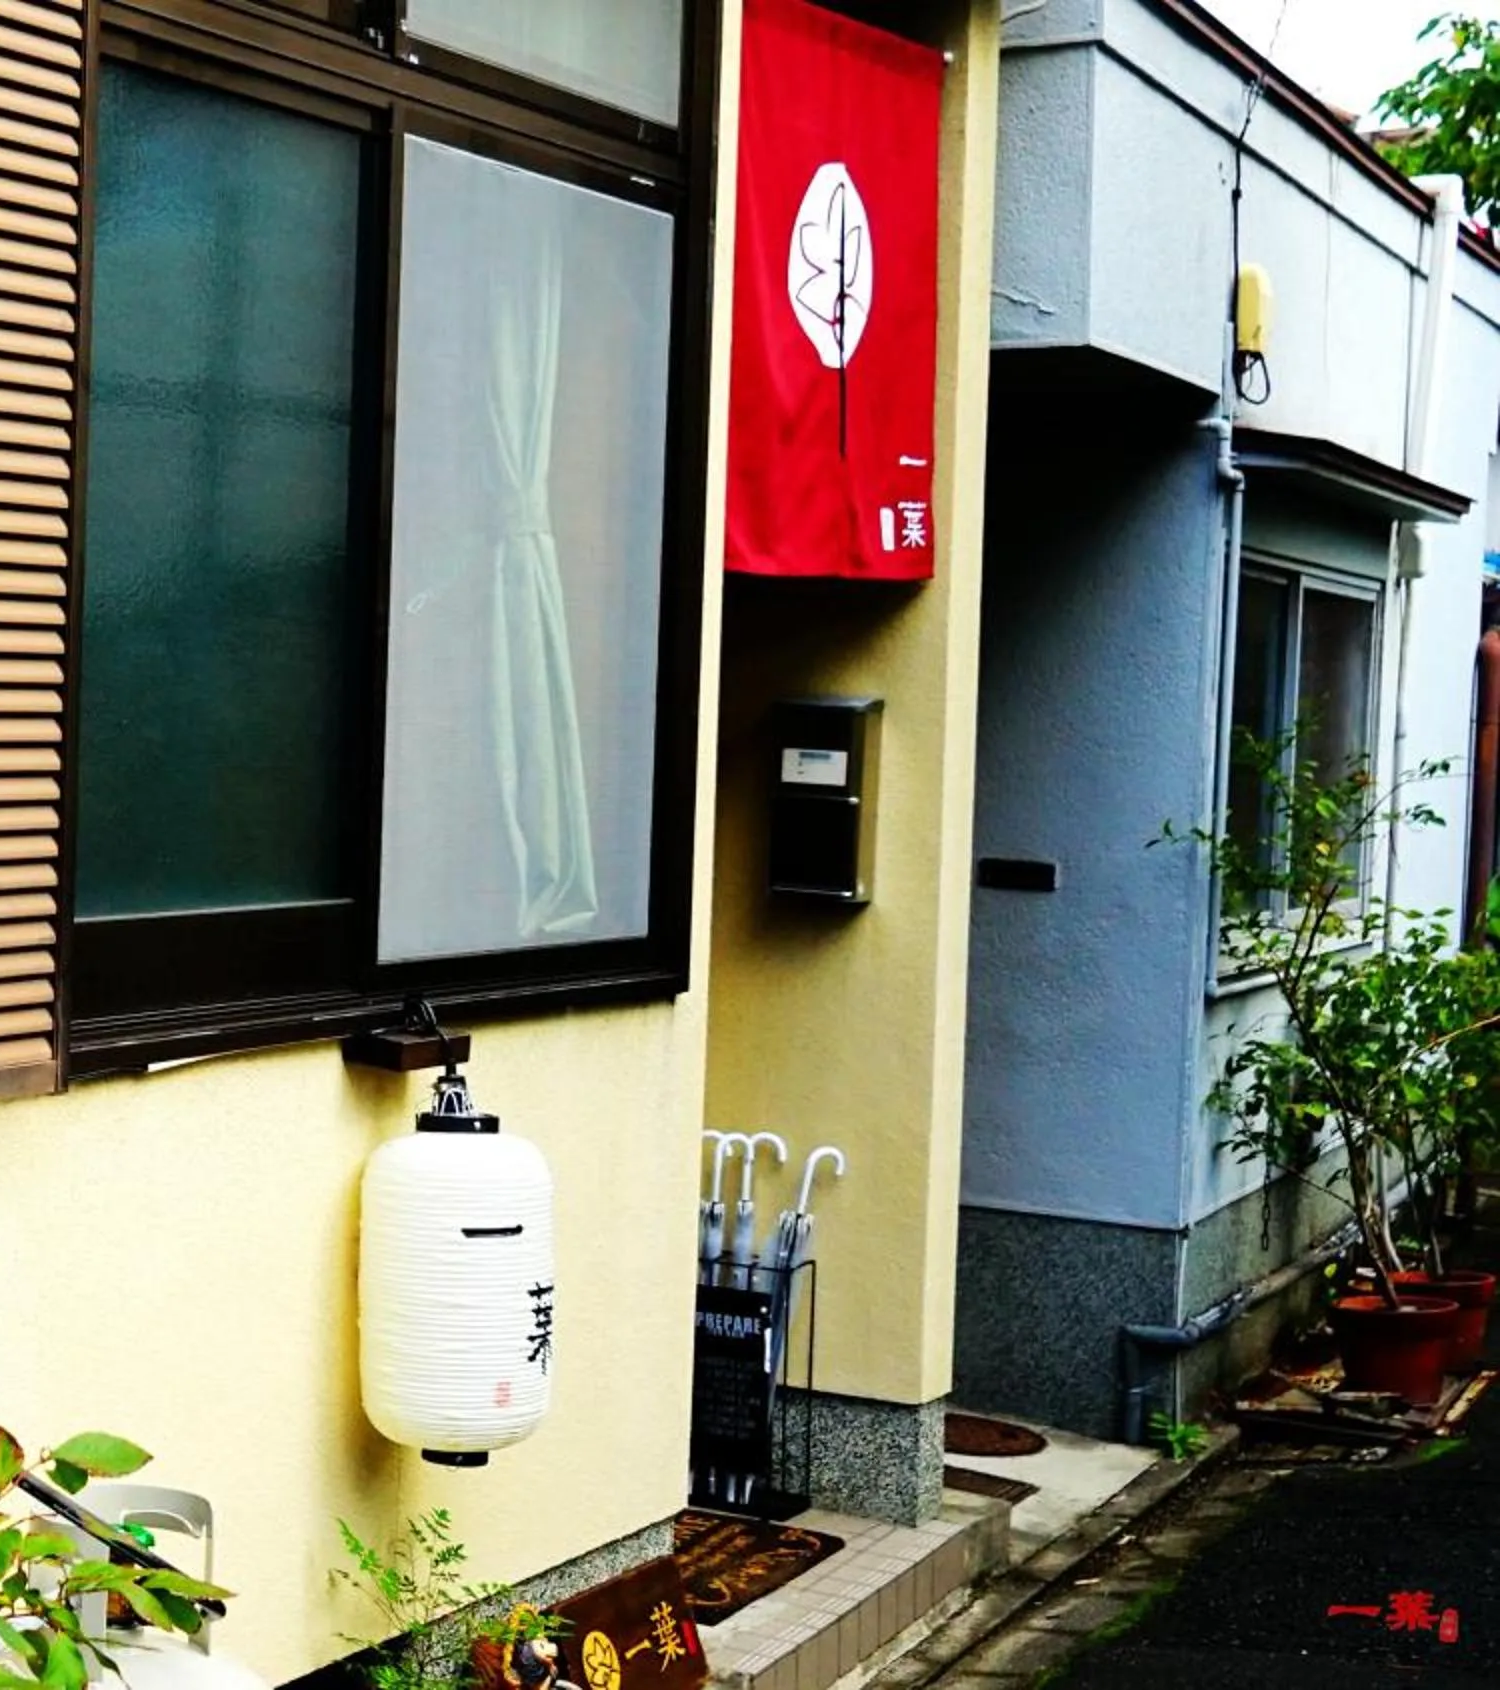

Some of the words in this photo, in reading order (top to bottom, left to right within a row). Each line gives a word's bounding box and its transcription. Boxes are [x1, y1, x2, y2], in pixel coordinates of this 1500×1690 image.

[897, 455, 927, 549] 一葉
[696, 1311, 761, 1335] PREPARE
[624, 1601, 686, 1673] 一葉
